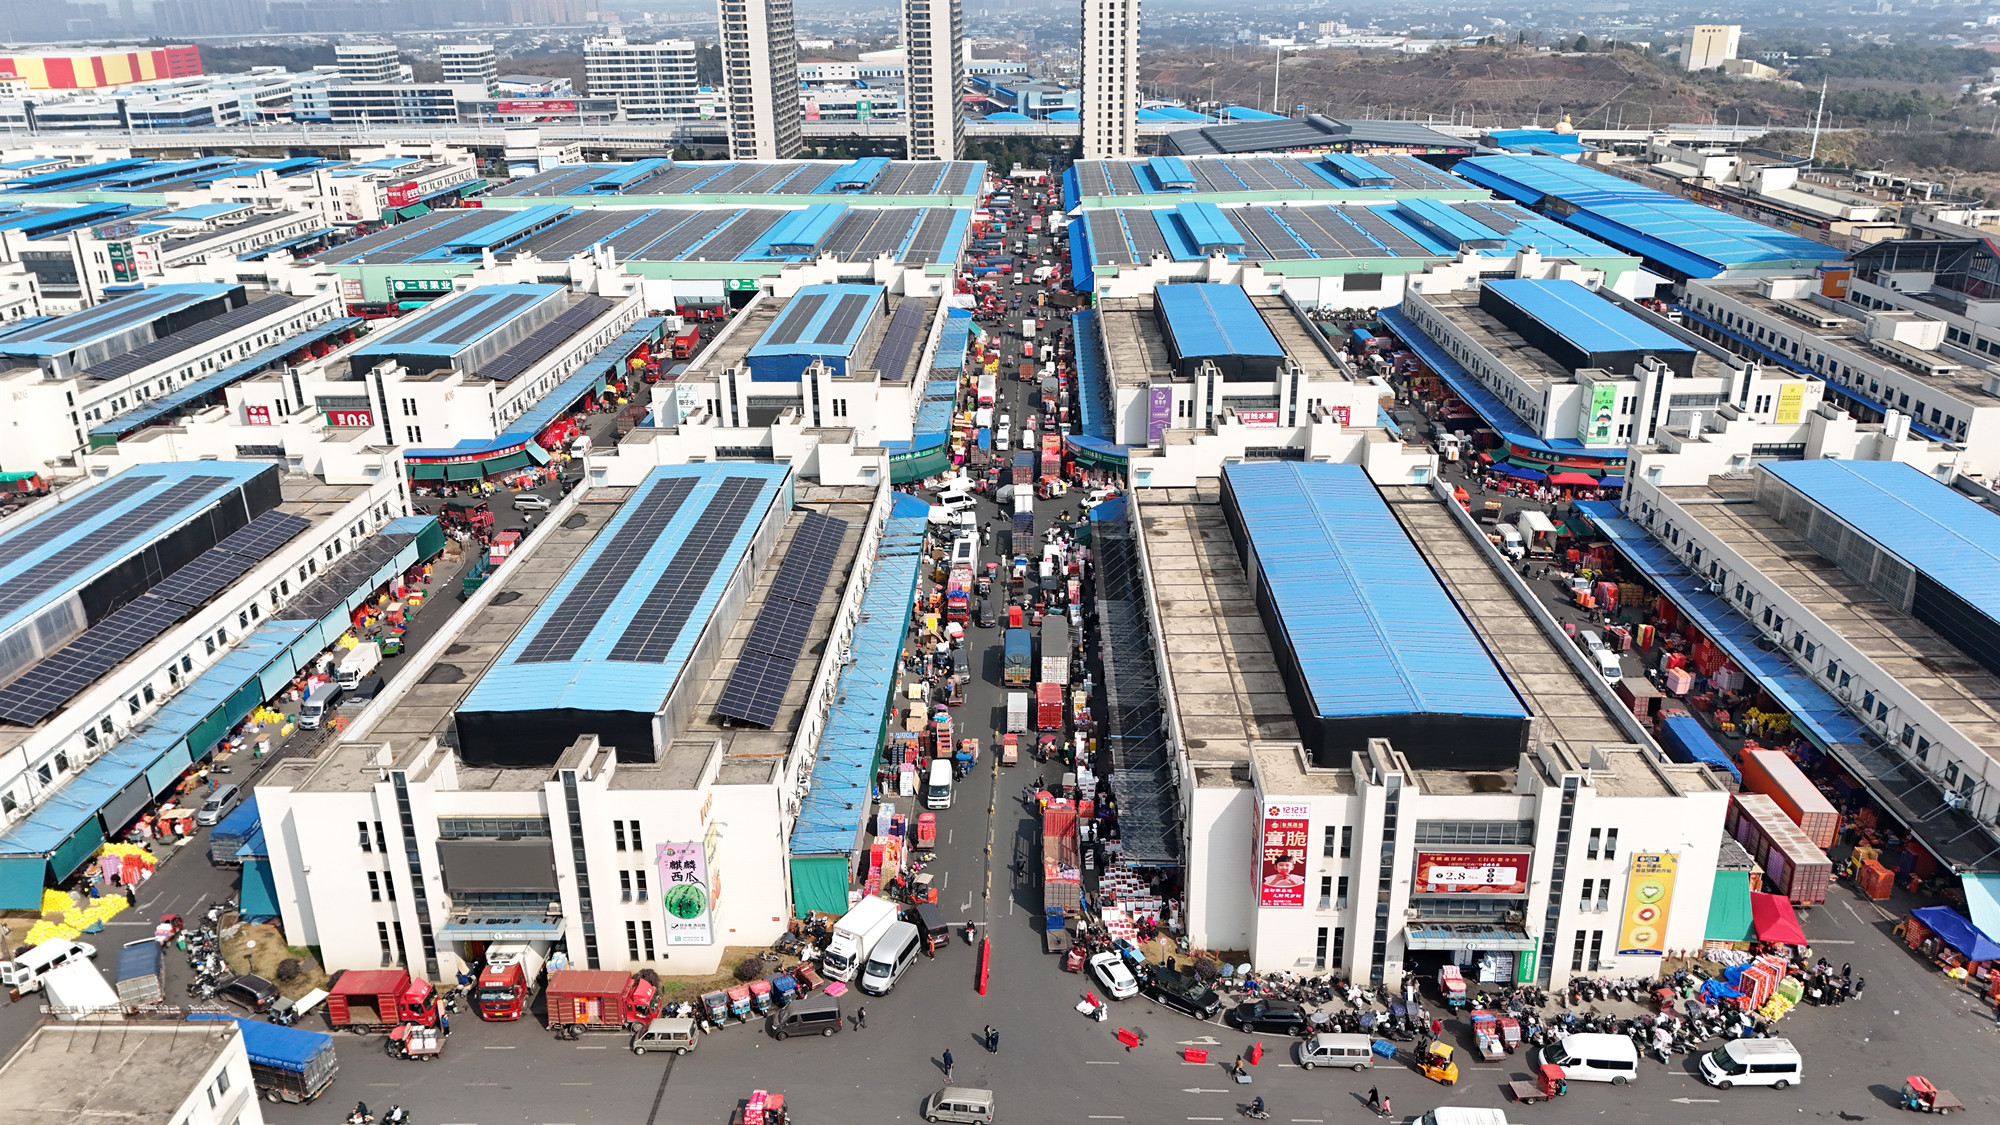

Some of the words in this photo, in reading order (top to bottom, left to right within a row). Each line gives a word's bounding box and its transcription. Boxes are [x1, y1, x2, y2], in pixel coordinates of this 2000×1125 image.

[407, 280, 452, 290] 二哥果业
[1264, 830, 1308, 847] 童脆
[1263, 849, 1306, 865] 苹果
[668, 859, 697, 871] 麒麟
[671, 871, 698, 883] 西瓜
[1445, 871, 1466, 881] 2.8
